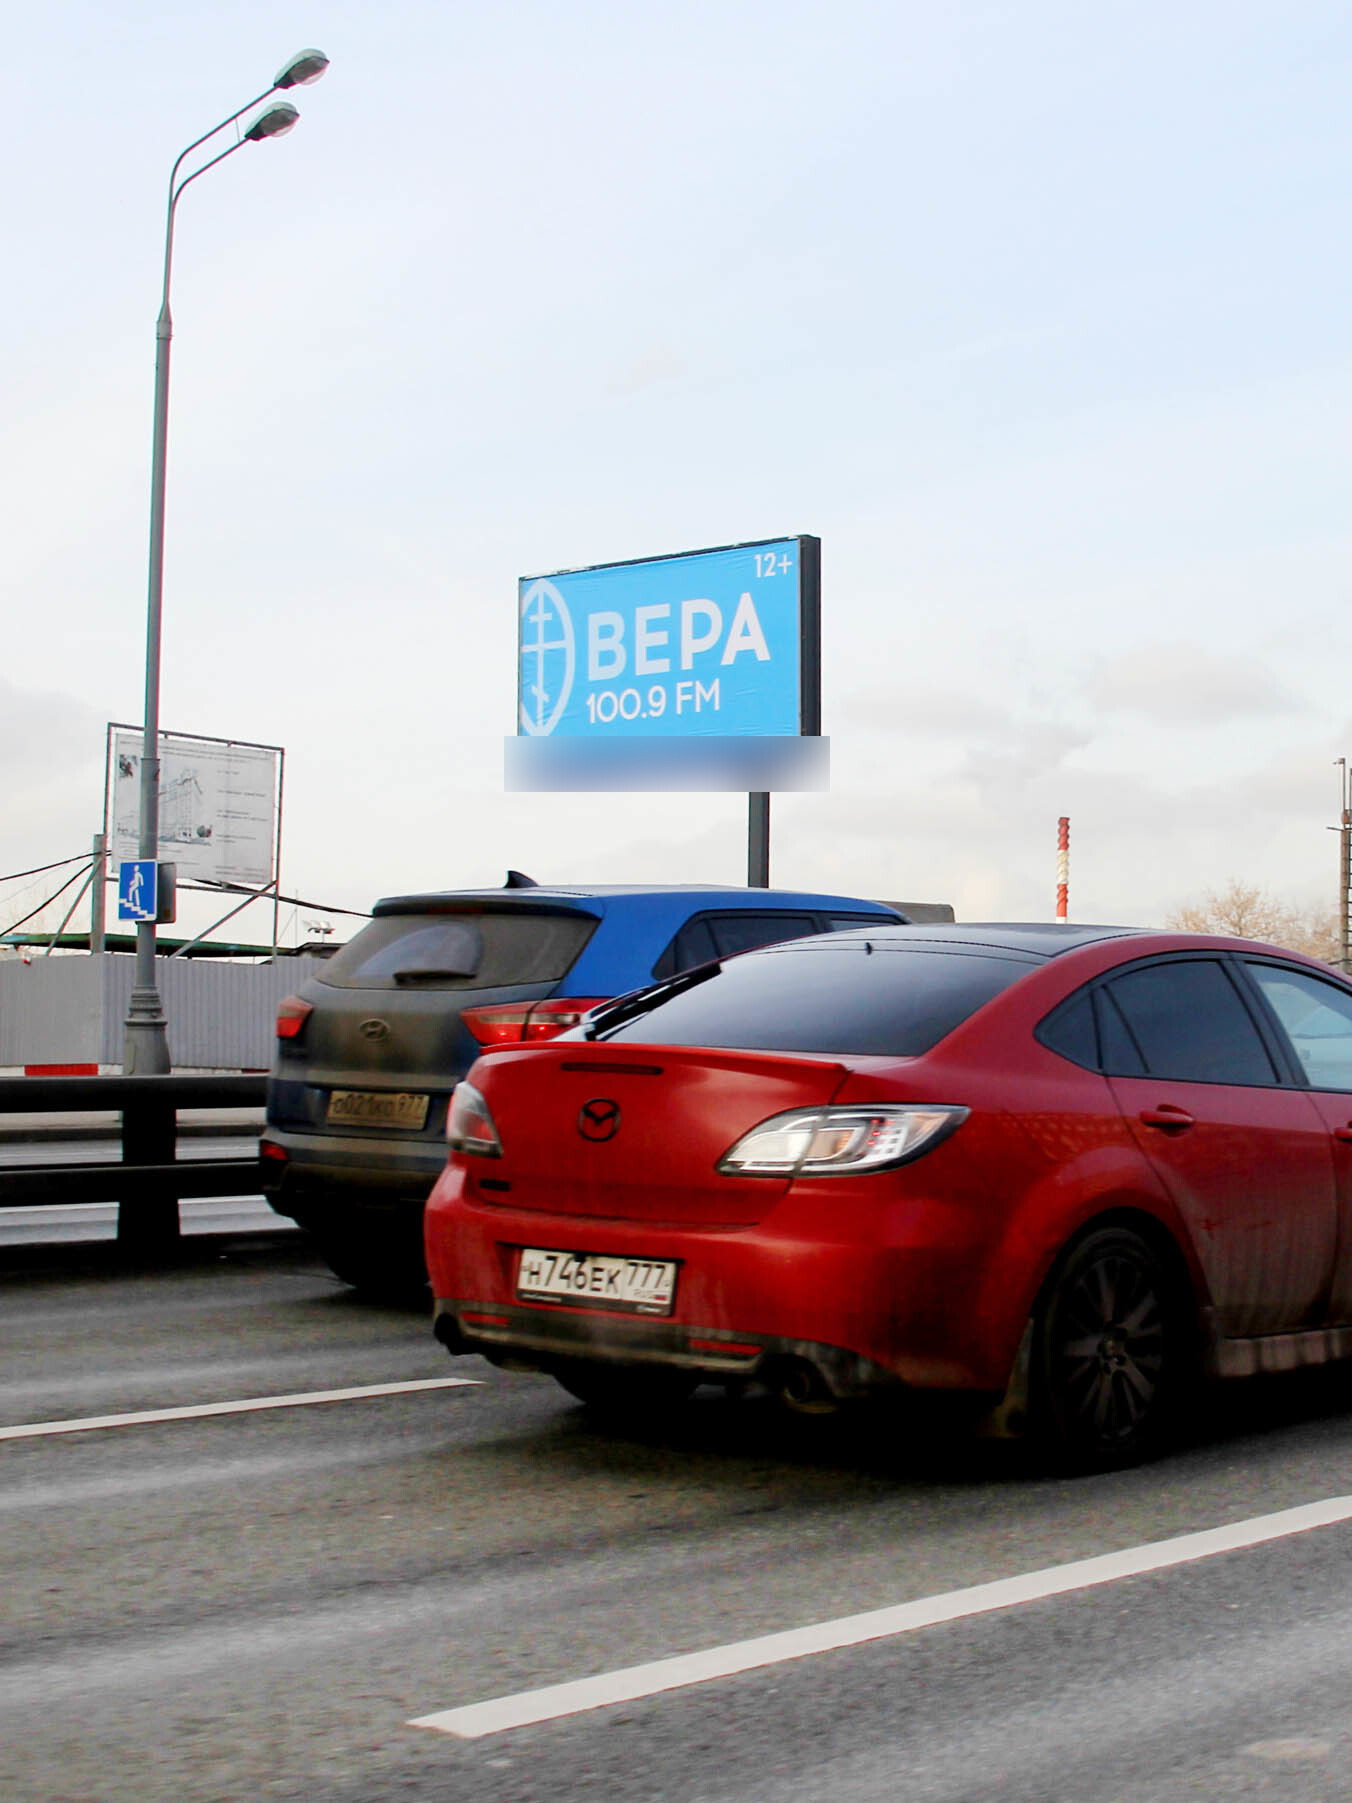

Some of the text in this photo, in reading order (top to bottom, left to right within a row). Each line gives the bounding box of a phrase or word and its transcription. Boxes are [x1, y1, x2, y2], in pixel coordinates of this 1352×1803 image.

[754, 552, 792, 578] 12+
[587, 591, 771, 681] ВЕРА
[586, 677, 721, 724] 100.9 FM
